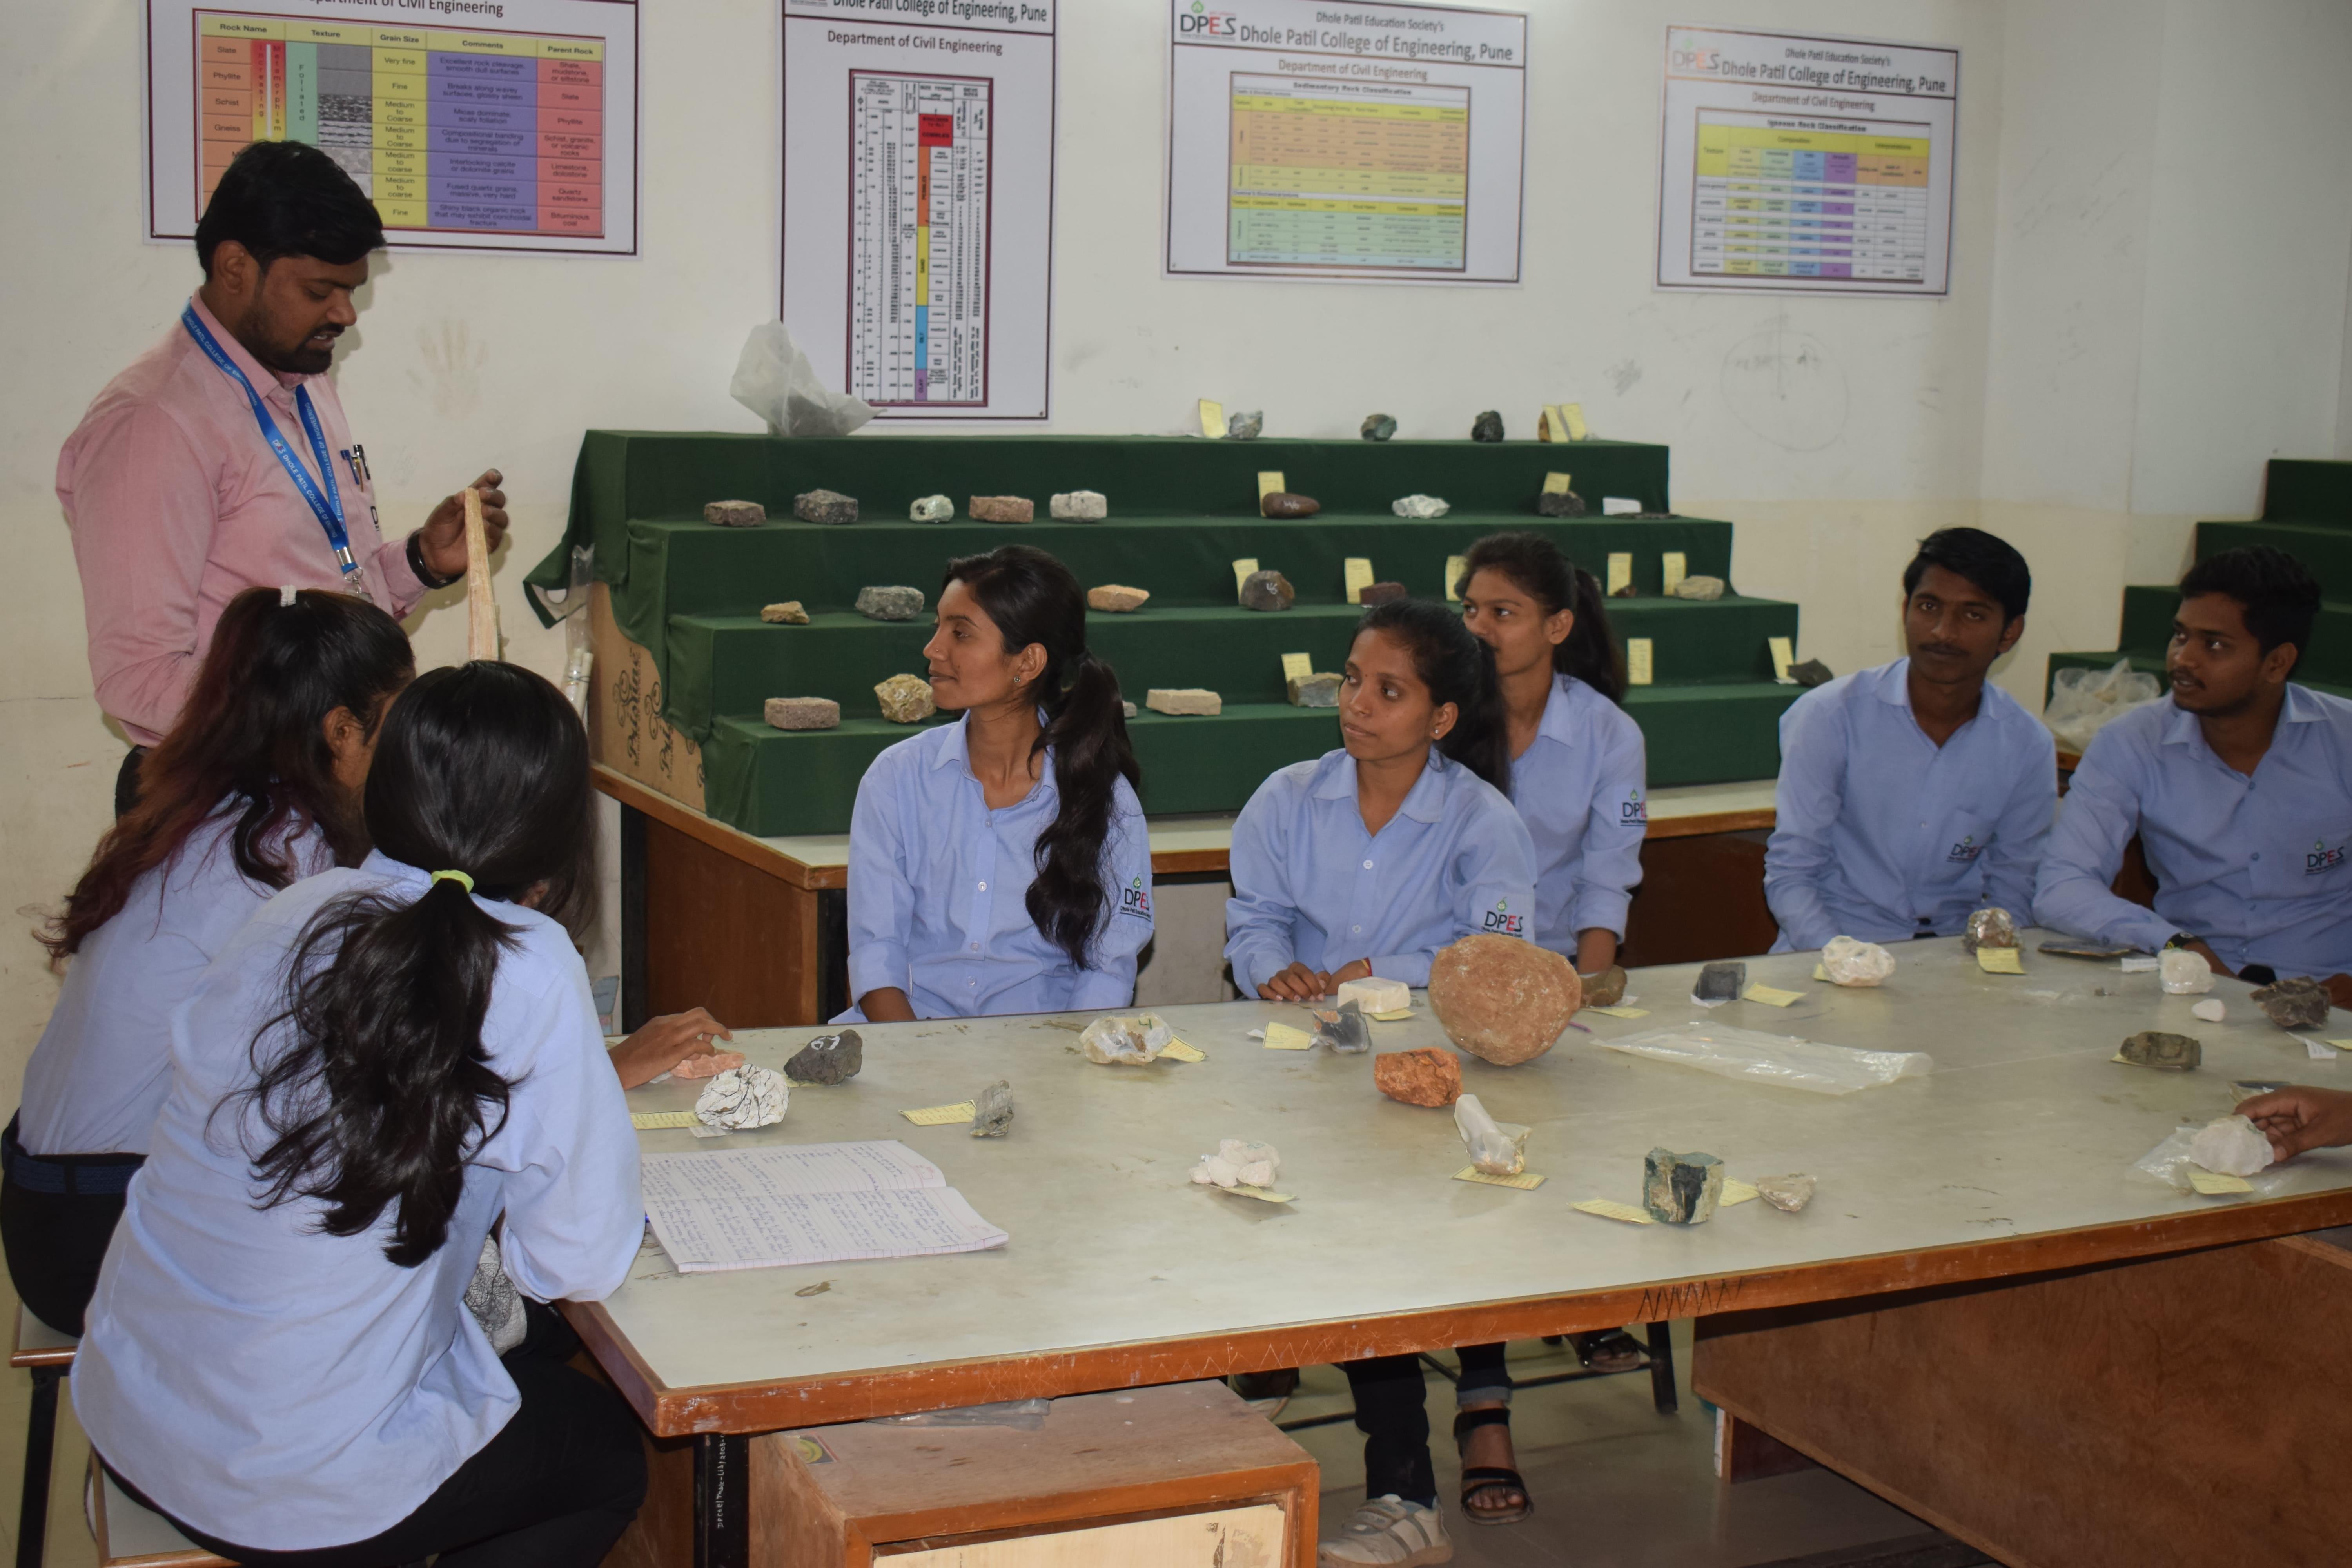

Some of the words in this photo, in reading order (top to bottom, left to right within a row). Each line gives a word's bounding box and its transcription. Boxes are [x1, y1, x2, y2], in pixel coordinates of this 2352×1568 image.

[429, 0, 503, 18] Engineering
[896, 0, 935, 17] College
[938, 1, 948, 15] of
[953, 2, 1018, 23] Engineering,
[1021, 5, 1047, 22] Pune
[1181, 15, 1236, 35] DPES
[1316, 11, 1341, 24] Dhole
[1344, 13, 1363, 27] Patil
[1365, 15, 1406, 30] Education
[1408, 19, 1445, 33] Society's
[463, 40, 503, 49] Comments
[828, 30, 895, 47] Department
[898, 35, 910, 47] of
[913, 36, 936, 49] Civil
[939, 38, 1003, 56] Engineering
[1240, 25, 1281, 44] Dhole
[1287, 29, 1317, 47] Patil
[1321, 31, 1370, 54] College
[1375, 34, 1390, 50] of
[1393, 36, 1475, 61] Engineering,
[1481, 43, 1513, 60] Pune
[385, 57, 400, 65] Very
[1672, 50, 1720, 70] DPES
[1785, 47, 1806, 59] Dhole
[1808, 49, 1823, 60] Patil
[1824, 51, 1858, 64] Education
[1279, 60, 1337, 75] Department
[1339, 62, 1350, 74] of
[1352, 62, 1371, 76] Civil
[1373, 64, 1427, 81] Engineering
[1722, 61, 1756, 78] Dhole
[1760, 64, 1784, 80] Patil
[1788, 66, 1829, 87] College
[1833, 68, 1846, 84] of
[1848, 70, 1915, 93] Engineering,
[1919, 76, 1946, 92] Pune
[1752, 92, 1800, 107] Department
[1802, 94, 1810, 105] of
[1812, 94, 1828, 107] Civil
[1830, 96, 1875, 112] Engineering
[205, 341, 225, 365] COLLEGE
[305, 402, 323, 439] ENGINEERING
[319, 440, 325, 448] OF
[321, 451, 333, 477] COLLEGE
[283, 455, 298, 474] DHOLE
[296, 474, 308, 490] PATIL
[307, 490, 325, 514] COLLEGE
[2307, 846, 2344, 867] DPES
[1484, 911, 1523, 932] DPES
